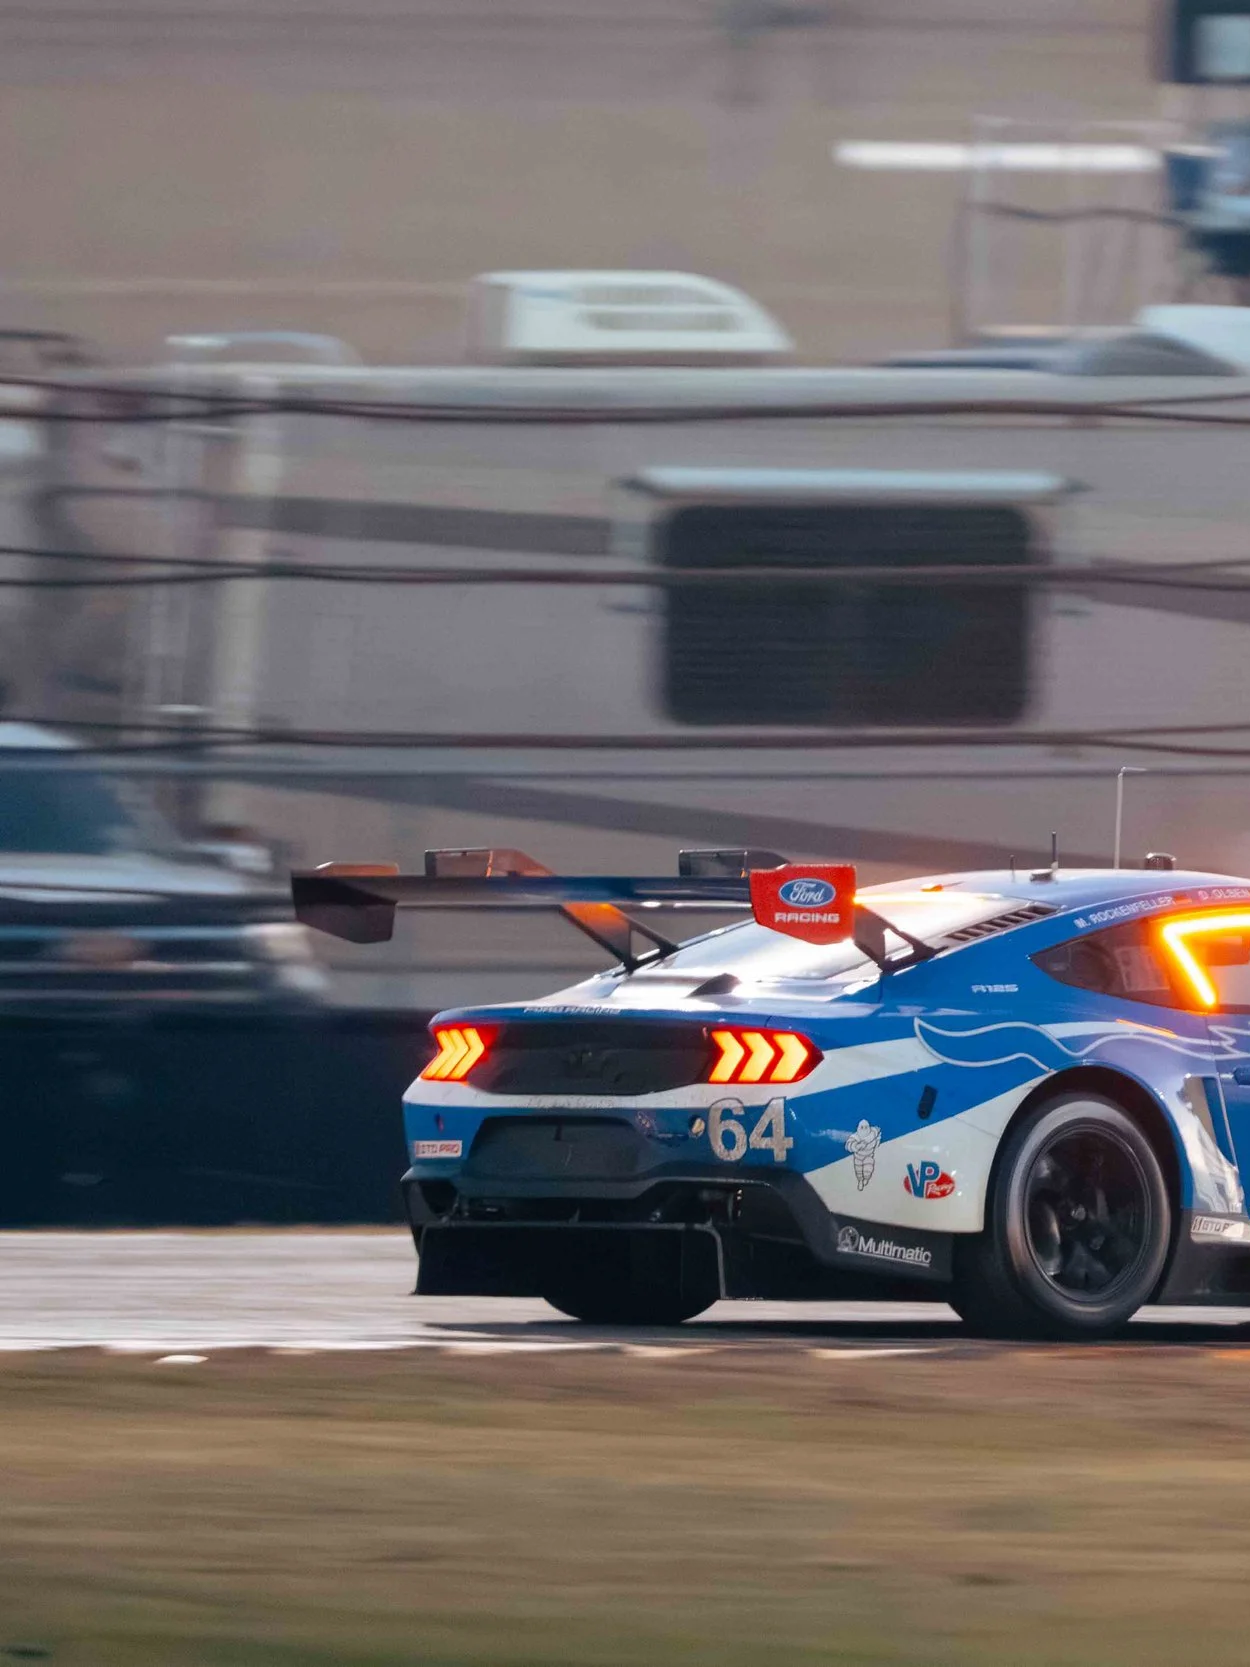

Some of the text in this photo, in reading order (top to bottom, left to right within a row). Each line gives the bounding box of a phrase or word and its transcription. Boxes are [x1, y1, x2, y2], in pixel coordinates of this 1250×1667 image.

[789, 881, 825, 902] Ford
[774, 912, 840, 924] RACING
[1073, 896, 1176, 928] M. ROCKENFELLER
[708, 1097, 794, 1162] 64
[906, 1160, 940, 1198] VP
[859, 1235, 932, 1264] Multimatic
